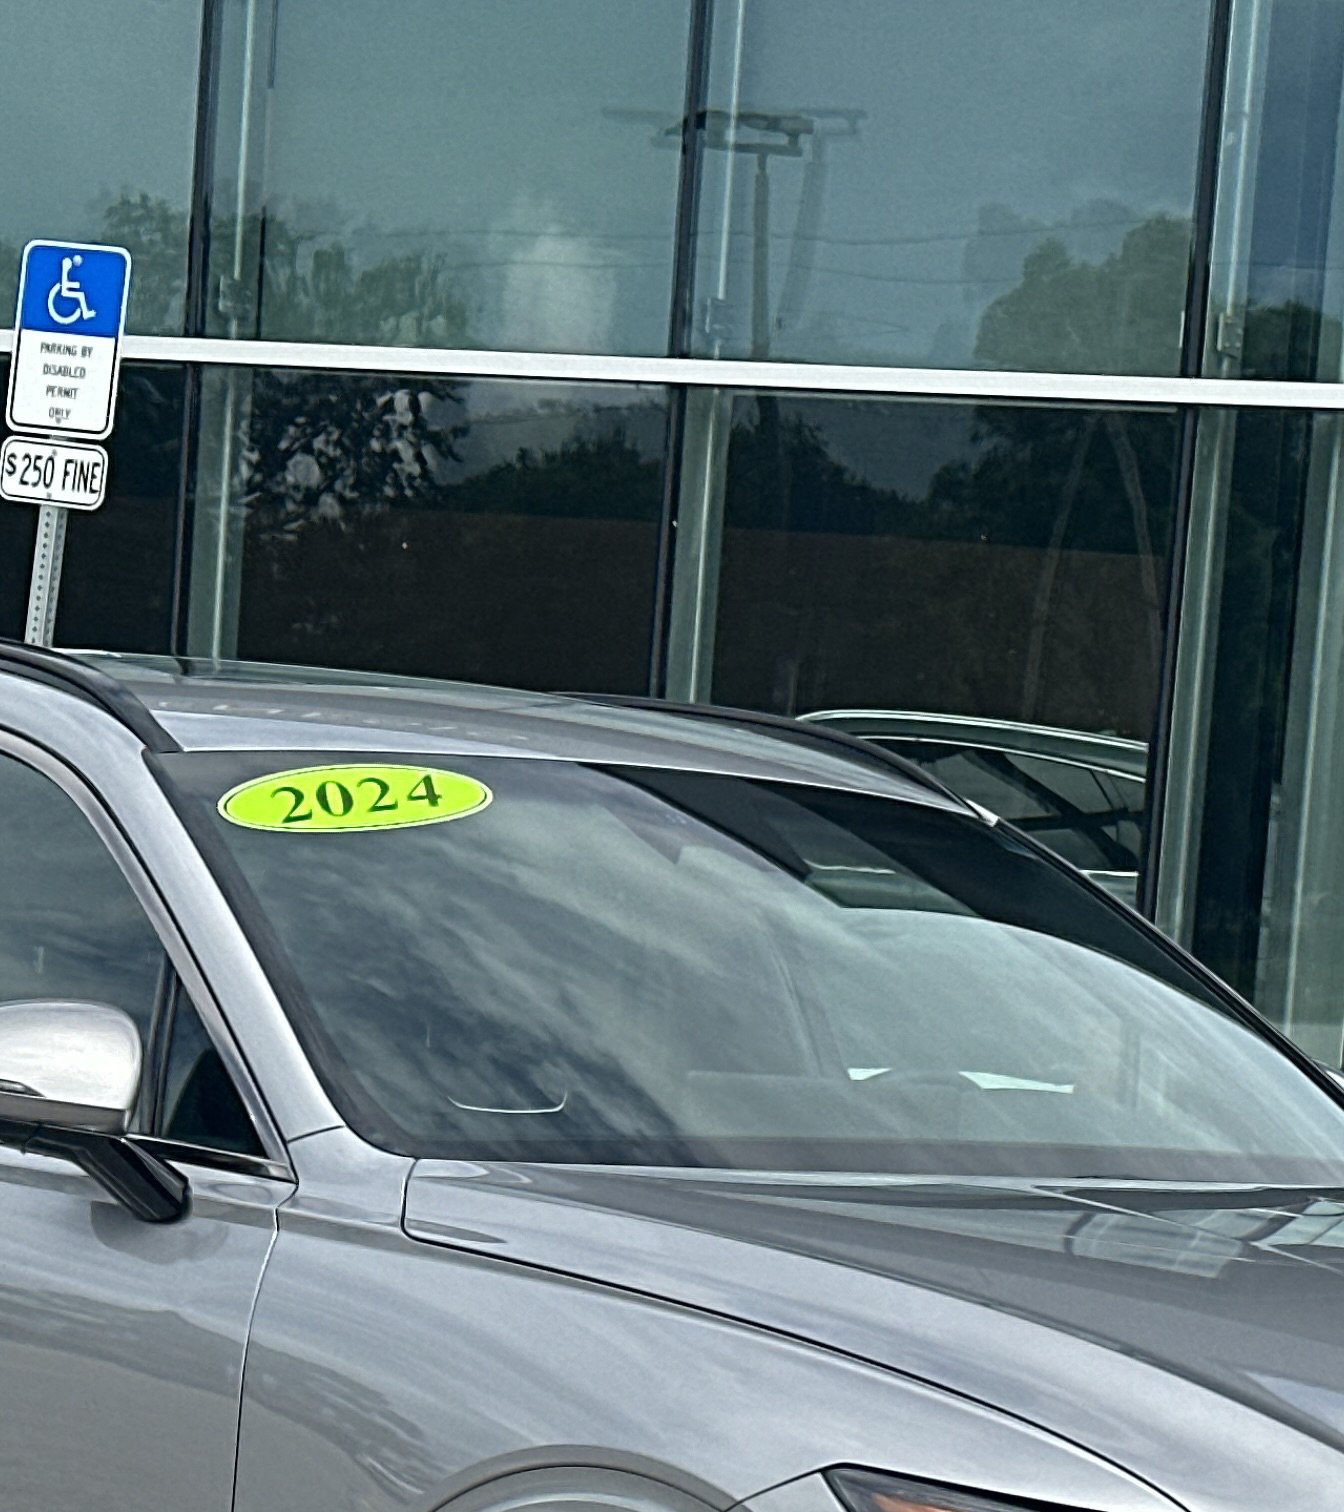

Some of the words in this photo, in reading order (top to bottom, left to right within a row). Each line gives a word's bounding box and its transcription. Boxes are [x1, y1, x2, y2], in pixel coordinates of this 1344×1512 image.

[40, 342, 77, 357] PARKING
[81, 345, 93, 358] BY
[42, 363, 86, 379] DISABLED
[46, 384, 79, 400] PERMIT
[48, 406, 71, 420] ONLY
[5, 452, 55, 489] $250
[62, 459, 101, 494] FINE
[269, 773, 443, 825] 2024
